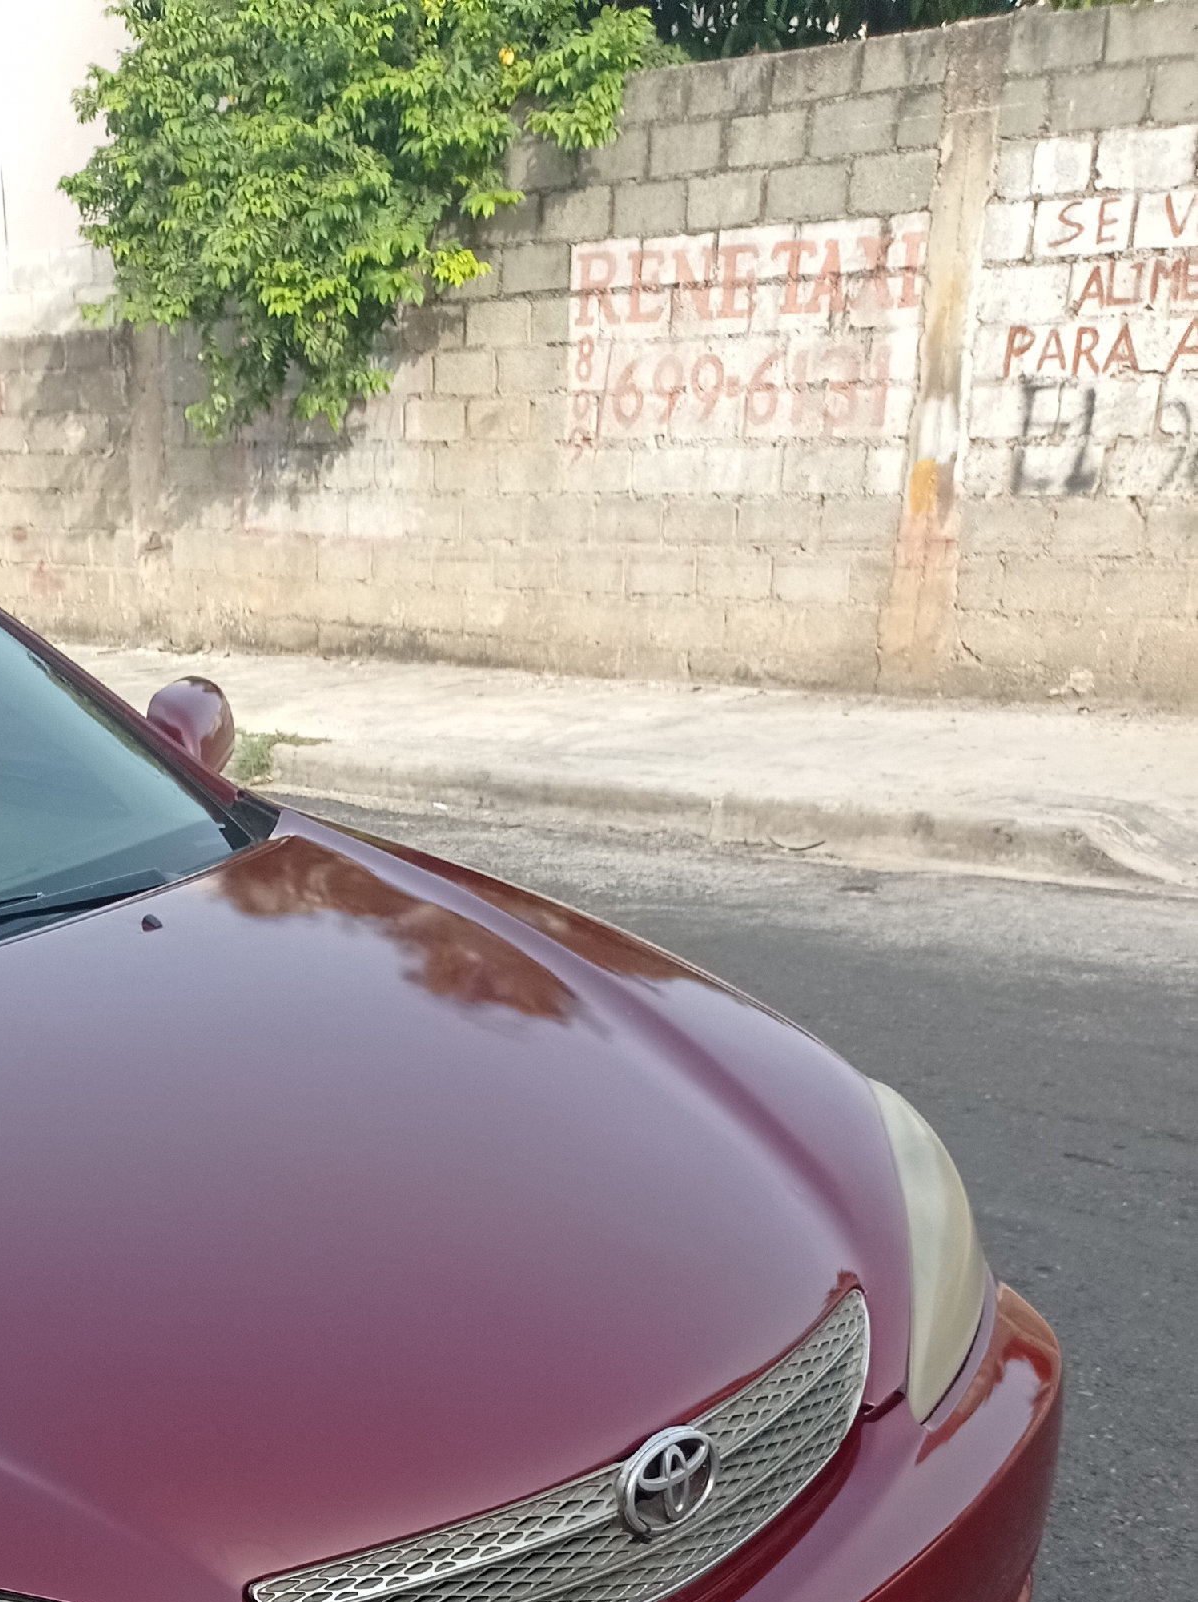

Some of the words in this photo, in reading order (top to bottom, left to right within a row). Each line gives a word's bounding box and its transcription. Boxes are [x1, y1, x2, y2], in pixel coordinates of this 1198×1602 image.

[1048, 197, 1122, 247] SE
[1164, 192, 1198, 240] V
[573, 243, 760, 327] RENE
[770, 230, 928, 316] TAXI
[1002, 322, 1140, 380] PARA
